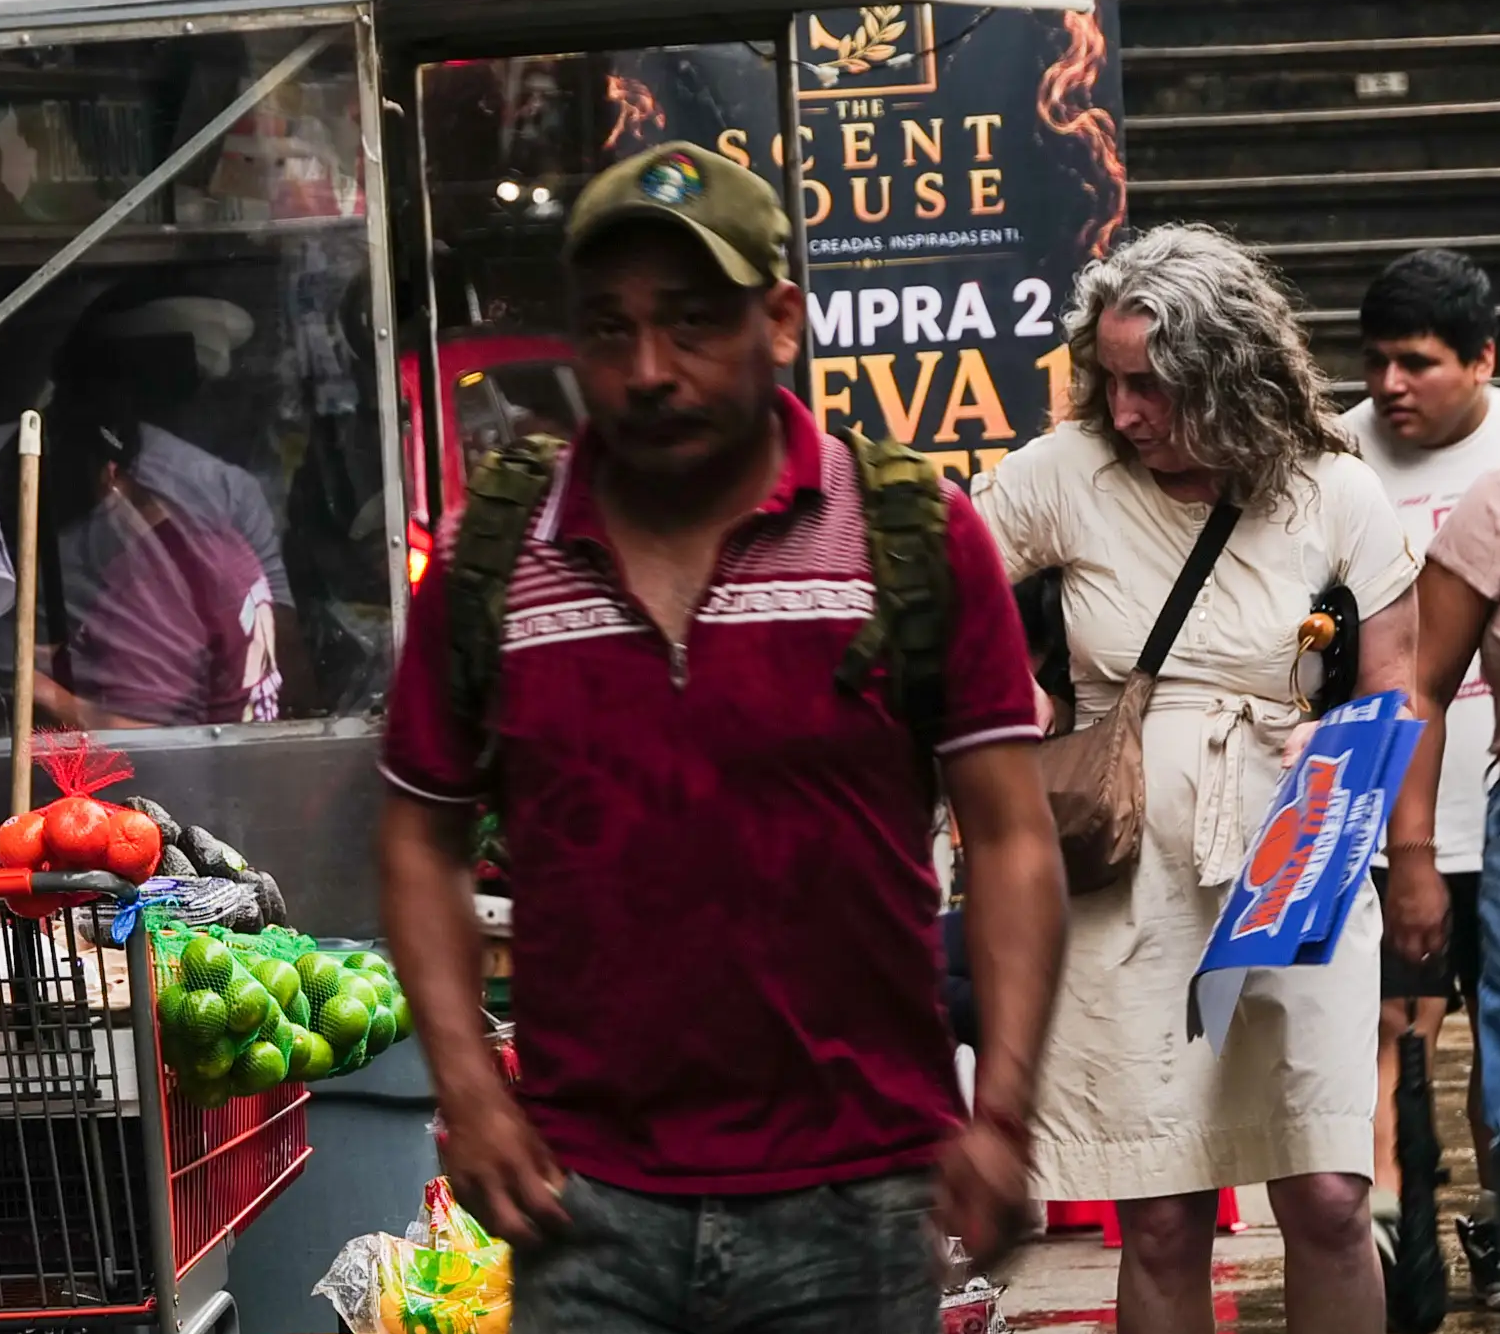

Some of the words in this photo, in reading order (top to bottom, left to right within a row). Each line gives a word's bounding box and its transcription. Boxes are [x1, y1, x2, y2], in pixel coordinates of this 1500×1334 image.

[835, 98, 886, 119] THE
[801, 168, 1006, 227] OUSE
[890, 230, 979, 249] INSPIRADAS
[806, 281, 997, 348] MPRA
[1012, 277, 1054, 337] 2
[812, 348, 1017, 446] EVA
